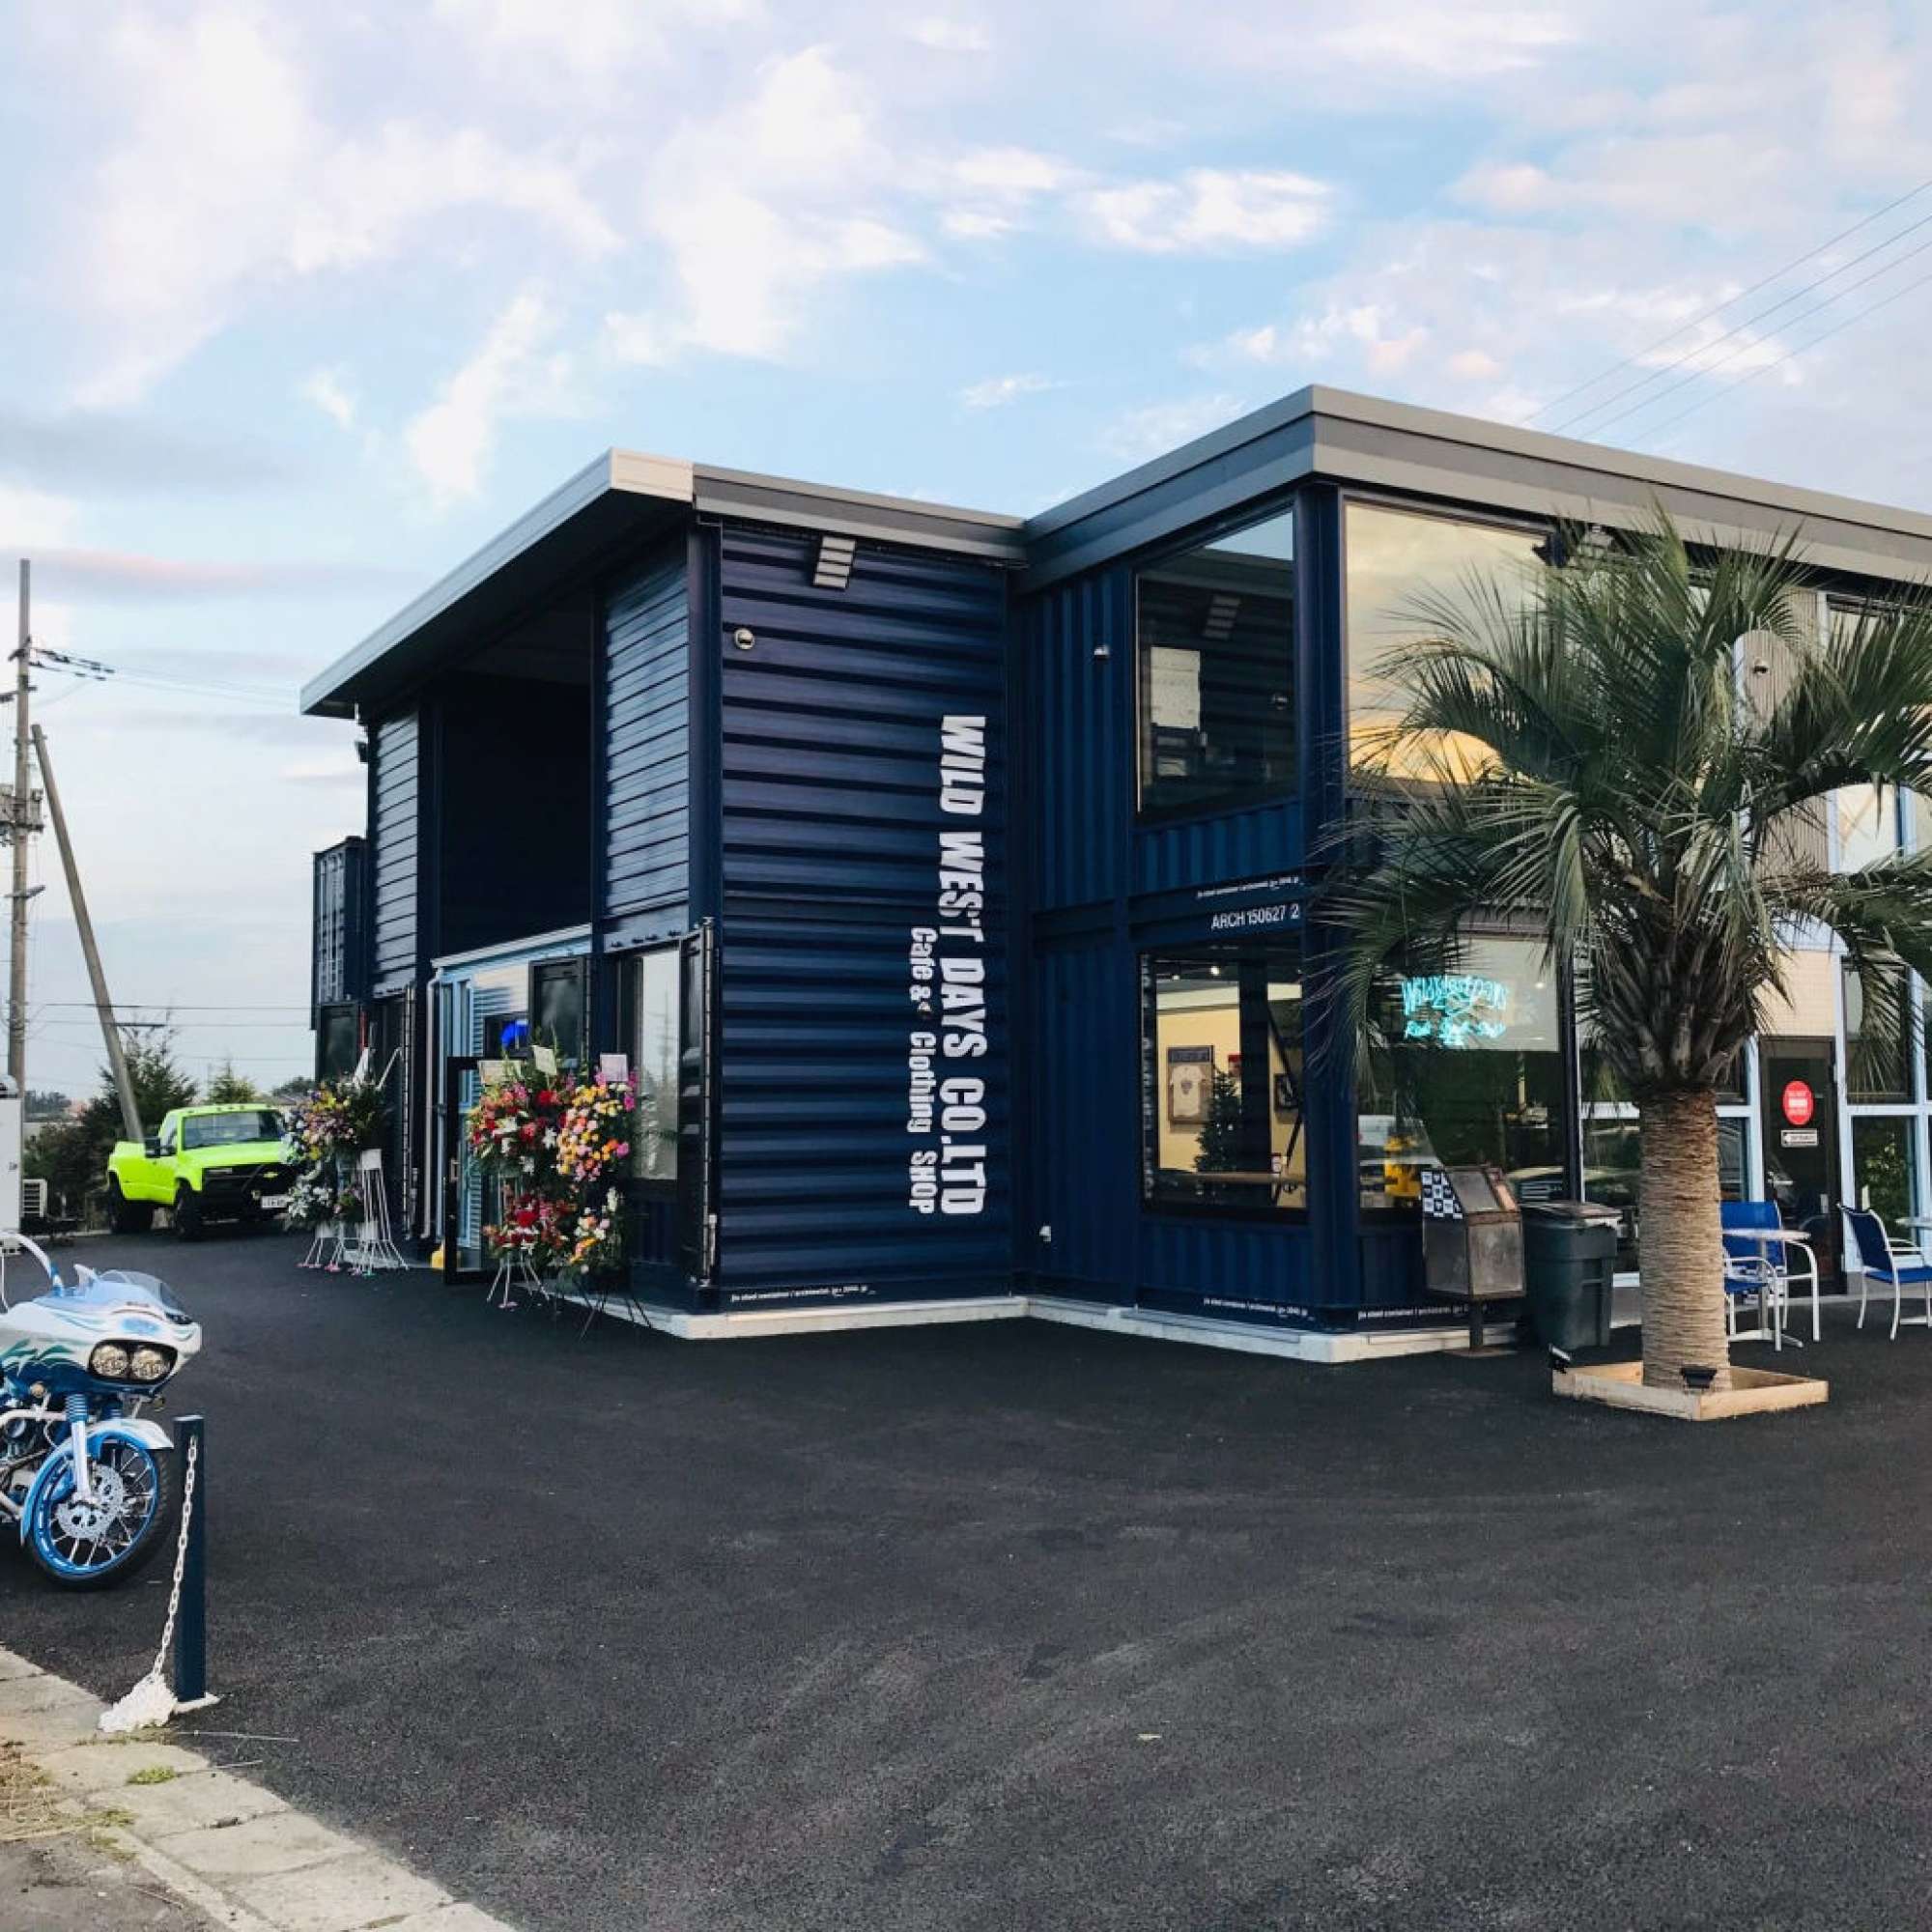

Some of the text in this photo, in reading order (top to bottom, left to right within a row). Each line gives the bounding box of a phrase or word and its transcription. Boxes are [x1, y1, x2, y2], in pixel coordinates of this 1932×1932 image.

[938, 715, 987, 1214] WILD WEST DAYS CO.LTD
[1210, 911, 1246, 929] ARCH
[906, 926, 938, 1214] Cafe & Clothing SHOP
